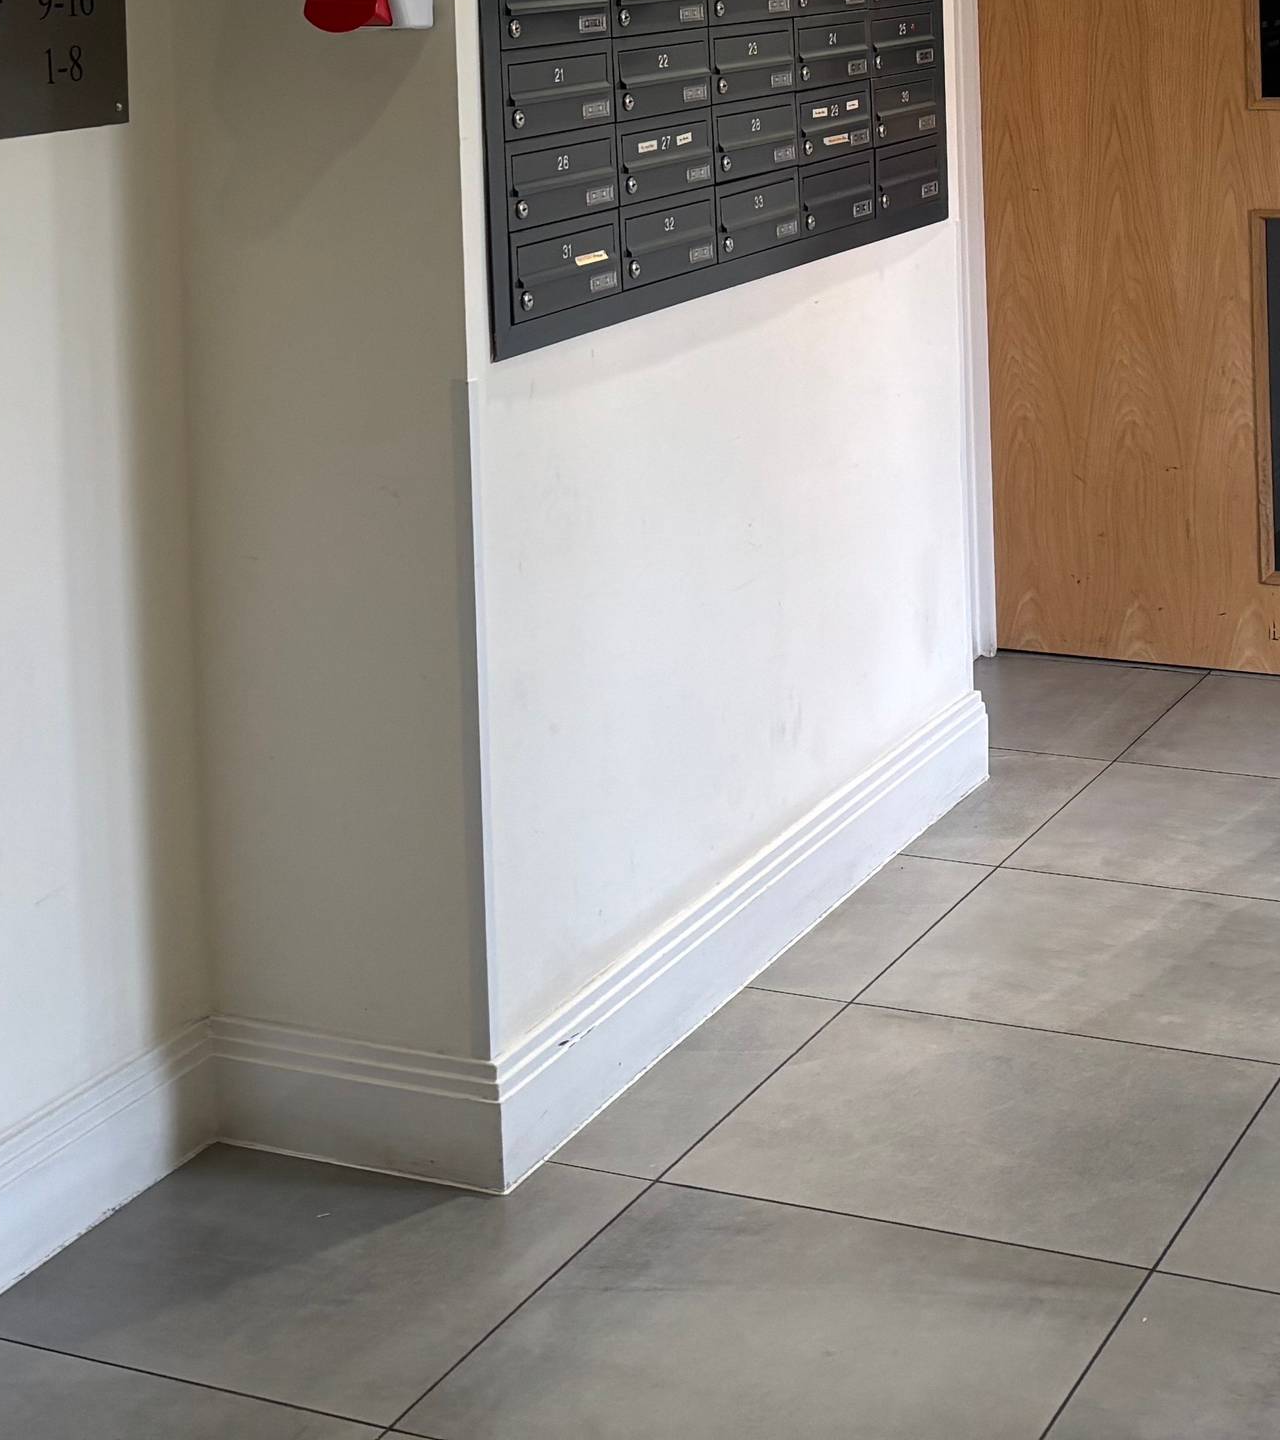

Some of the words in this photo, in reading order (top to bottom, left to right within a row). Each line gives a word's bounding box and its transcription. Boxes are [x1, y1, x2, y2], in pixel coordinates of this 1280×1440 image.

[899, 23, 907, 36] 25
[828, 32, 837, 45] 24
[748, 41, 758, 56] 23
[45, 44, 84, 85] 1-8
[658, 54, 669, 68] 22
[554, 67, 564, 83] 21
[661, 135, 671, 150] 27
[557, 154, 569, 171] 26
[754, 194, 764, 209] 33
[664, 216, 675, 232] 32
[562, 243, 572, 259] 31
